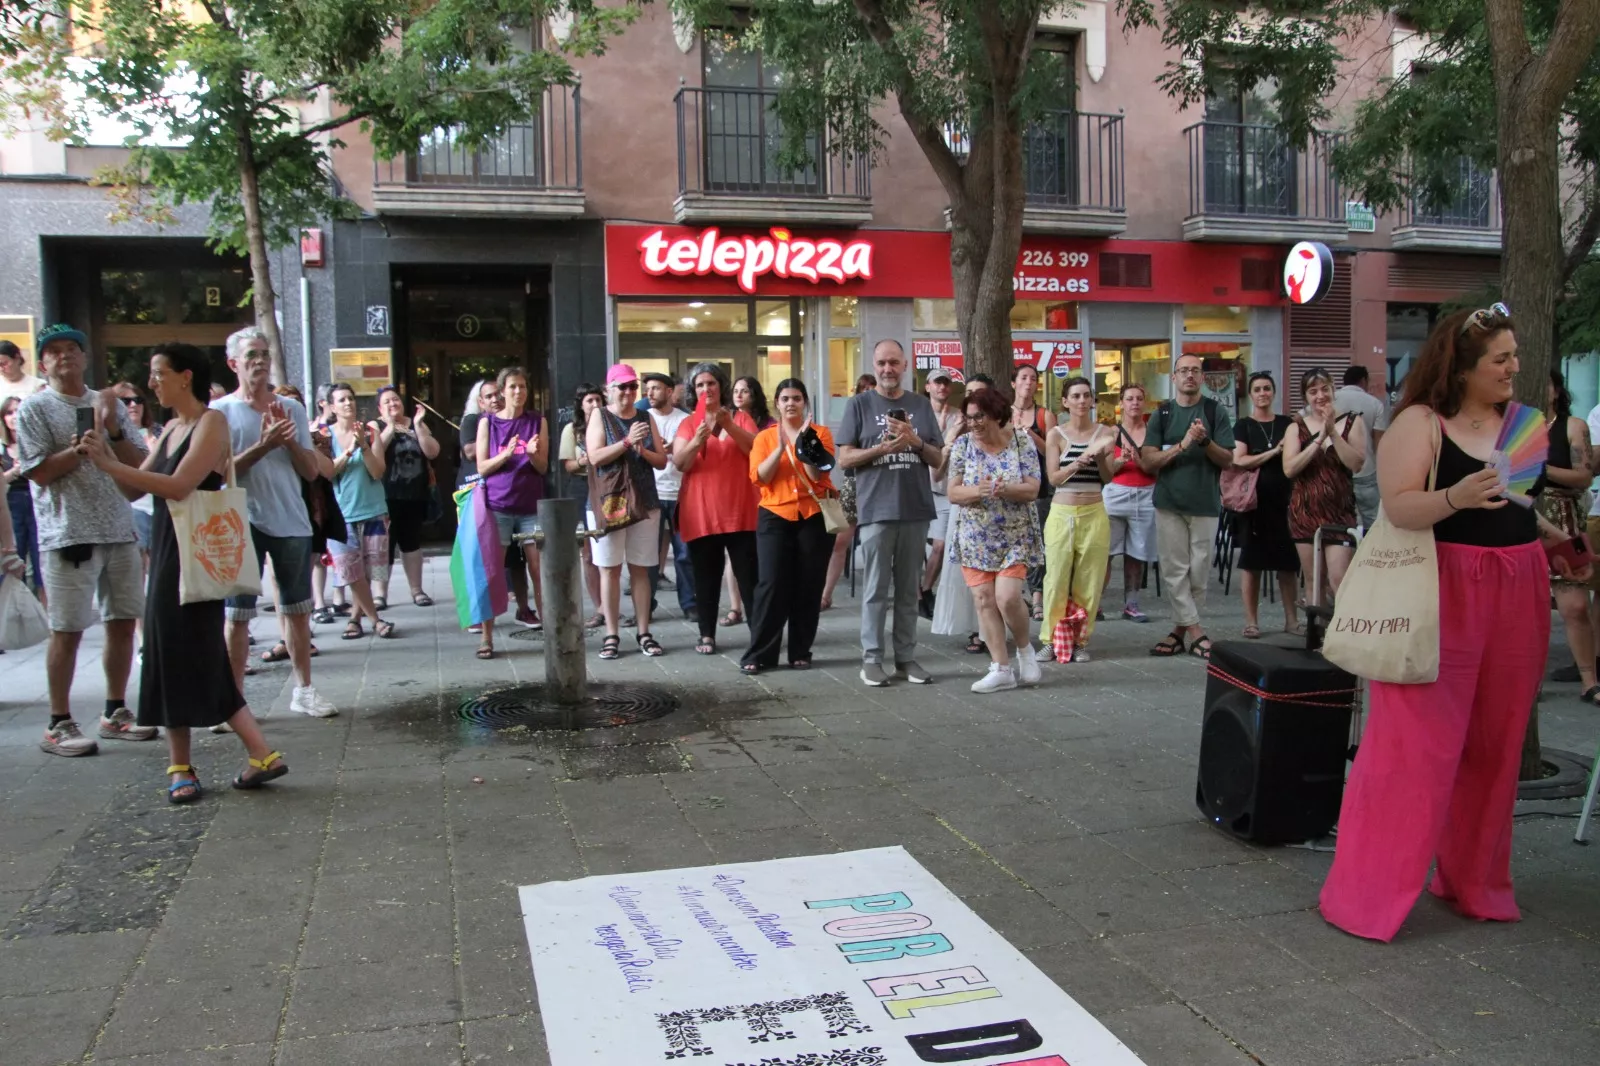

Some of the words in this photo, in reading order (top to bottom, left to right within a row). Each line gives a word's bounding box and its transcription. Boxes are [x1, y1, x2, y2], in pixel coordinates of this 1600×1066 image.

[639, 228, 872, 291] telepizza
[1022, 250, 1053, 266] 226
[1059, 252, 1089, 267] 399
[208, 289, 217, 303] 2
[464, 318, 473, 333] 3
[916, 343, 935, 354] PIZZA
[939, 343, 962, 354] BEBIDA
[916, 357, 928, 369] SIN
[929, 357, 940, 369] FIN
[872, 453, 896, 466] DON'T
[1336, 617, 1377, 634] LADY
[1379, 617, 1410, 634] PIPA
[804, 891, 954, 964] POR
[862, 965, 1003, 1020] EL
[905, 1019, 1070, 1066] D
